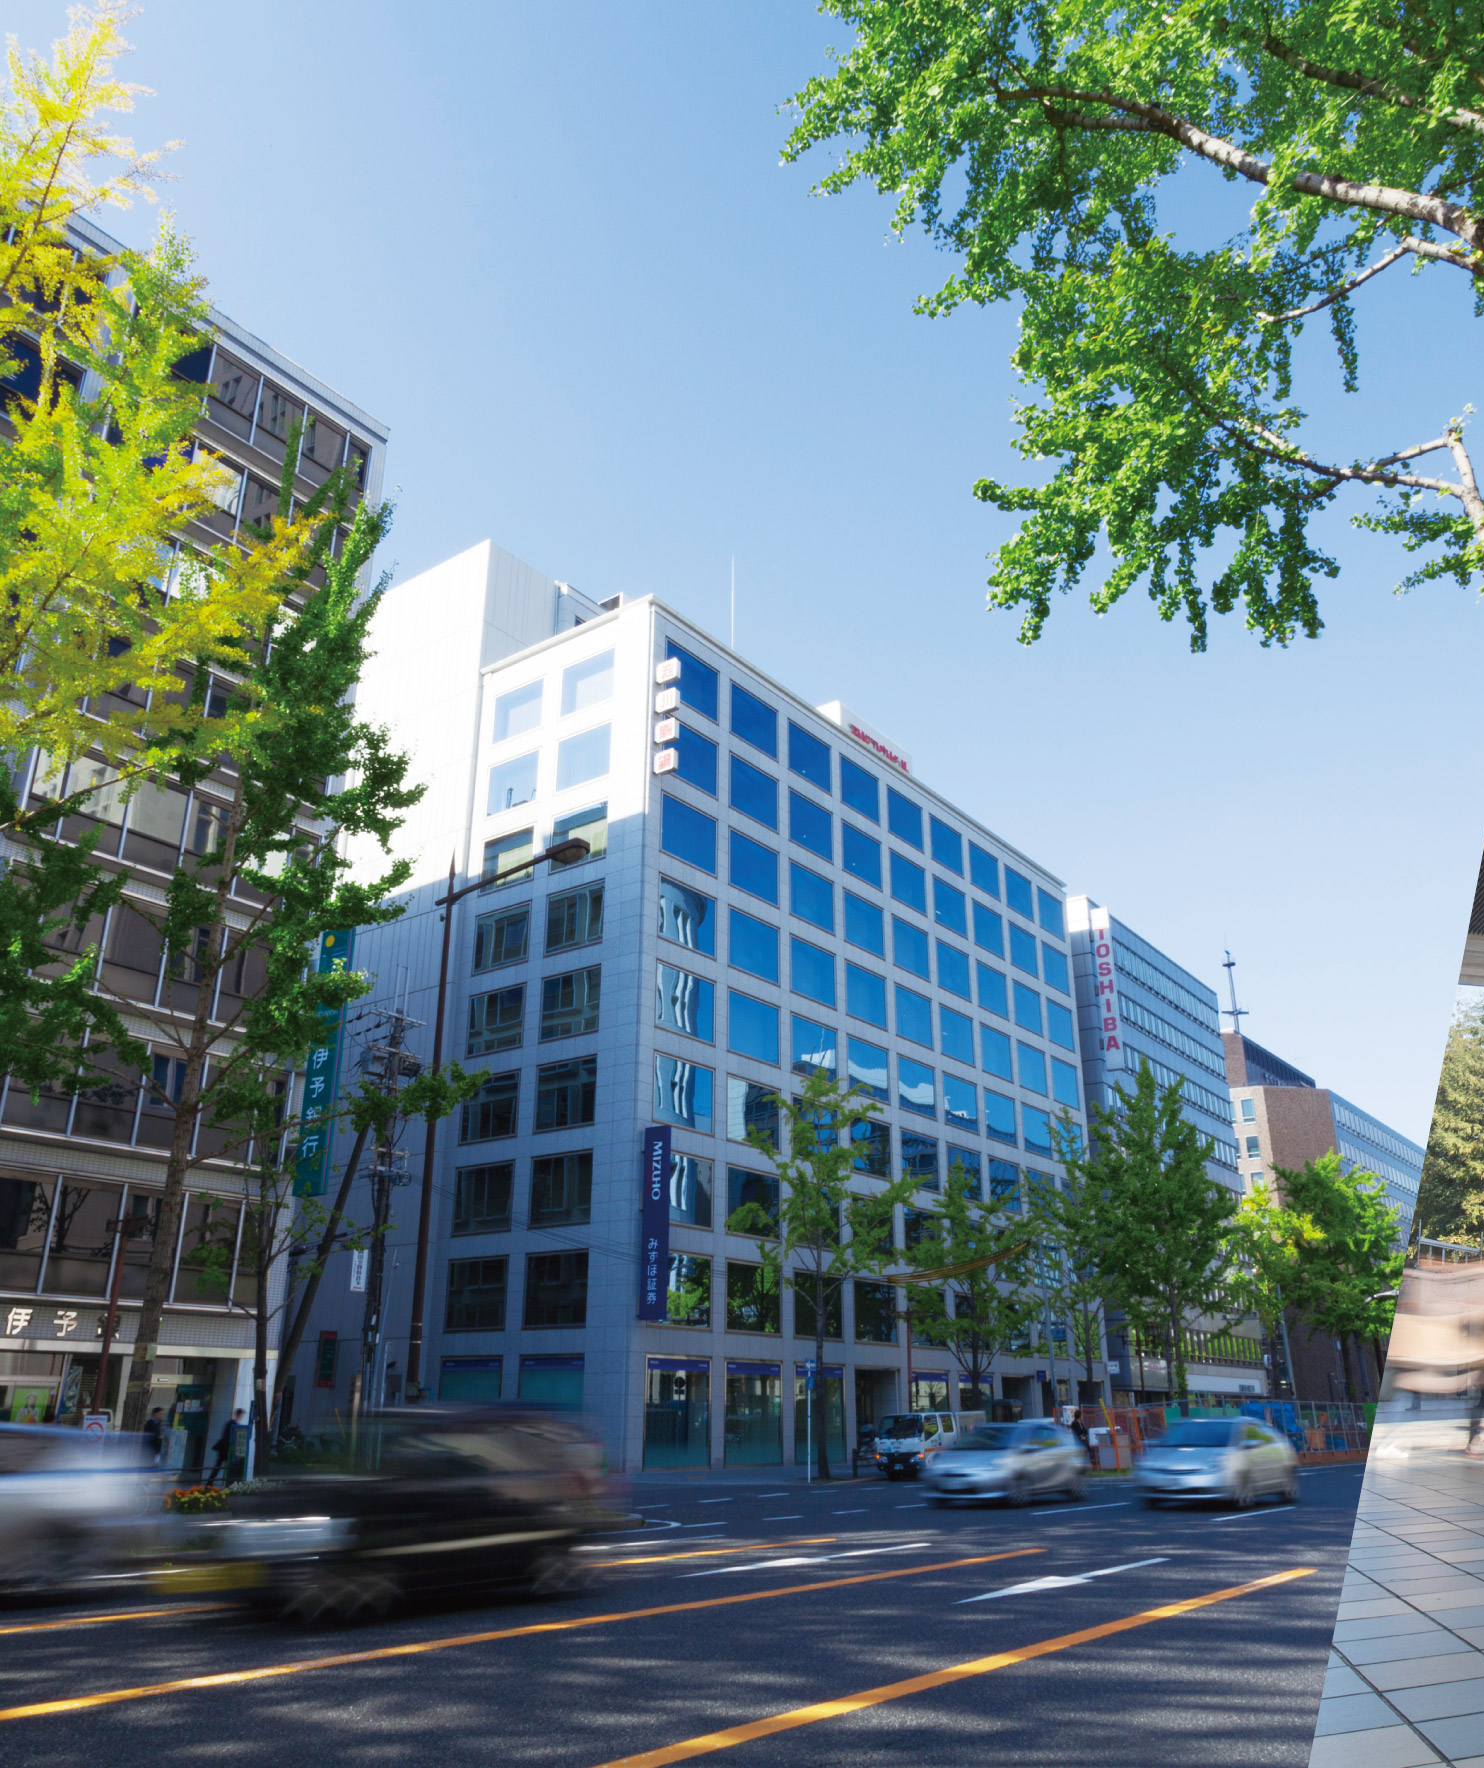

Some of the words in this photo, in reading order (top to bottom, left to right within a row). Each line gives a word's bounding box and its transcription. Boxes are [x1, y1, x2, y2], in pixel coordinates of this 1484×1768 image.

[1094, 928, 1120, 1051] TOSHIBA
[651, 1141, 663, 1201] MIZUHO
[646, 1237, 658, 1304] みずほ証券
